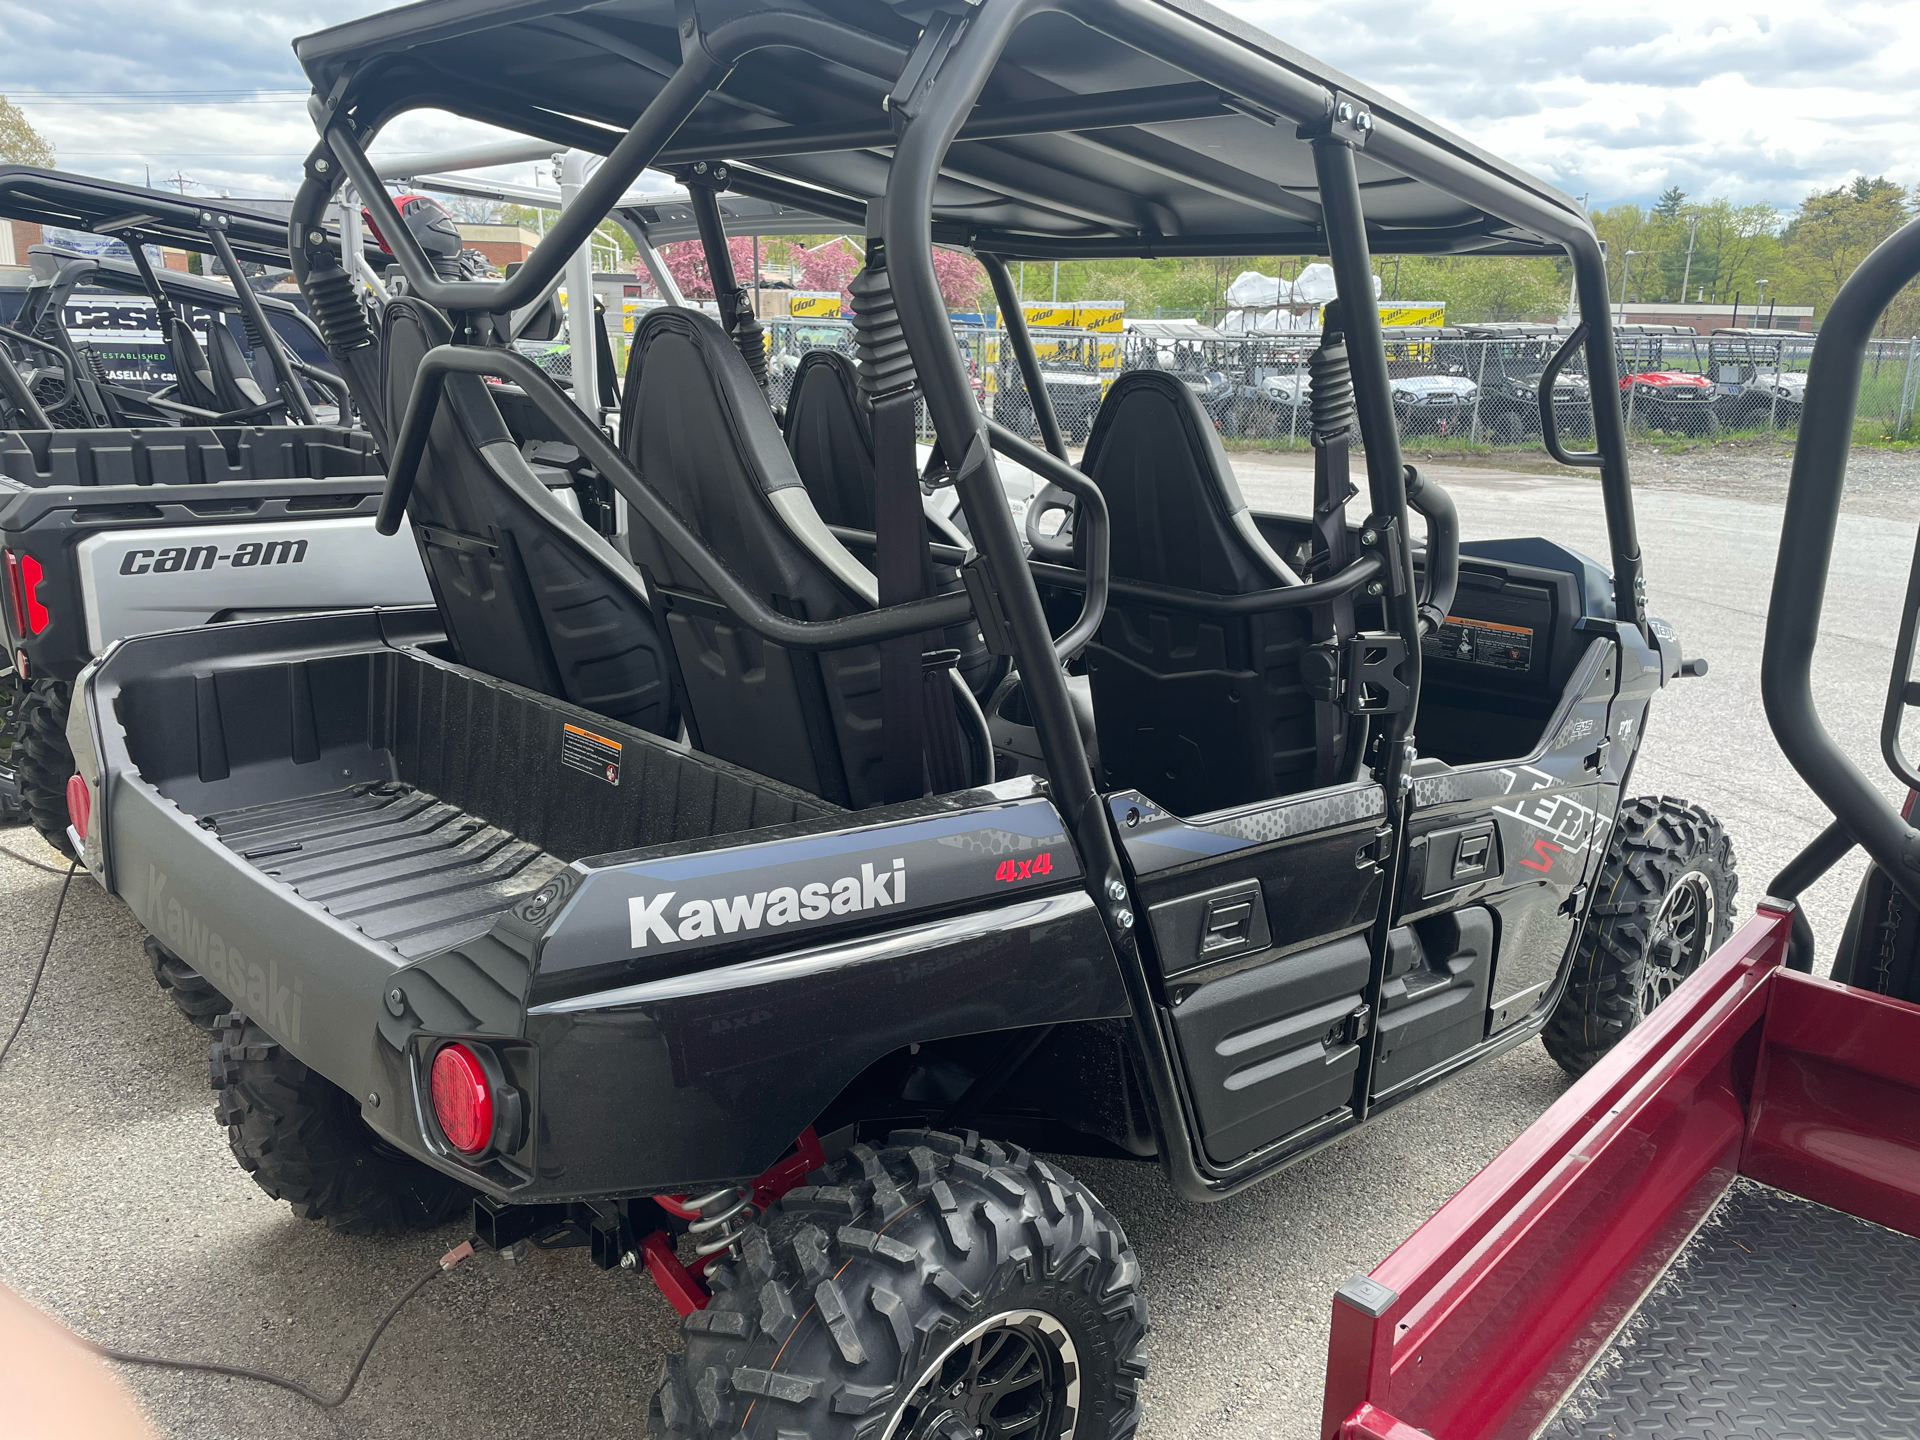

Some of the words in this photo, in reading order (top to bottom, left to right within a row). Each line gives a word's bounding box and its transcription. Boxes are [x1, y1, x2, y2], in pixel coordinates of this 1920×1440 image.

[102, 352, 166, 361] ESTABLISHED
[119, 539, 309, 576] can-am
[1518, 838, 1562, 873] S
[627, 857, 907, 949] Kawasaki
[995, 852, 1054, 883] 4x4
[146, 862, 304, 1046] Kawasaki
